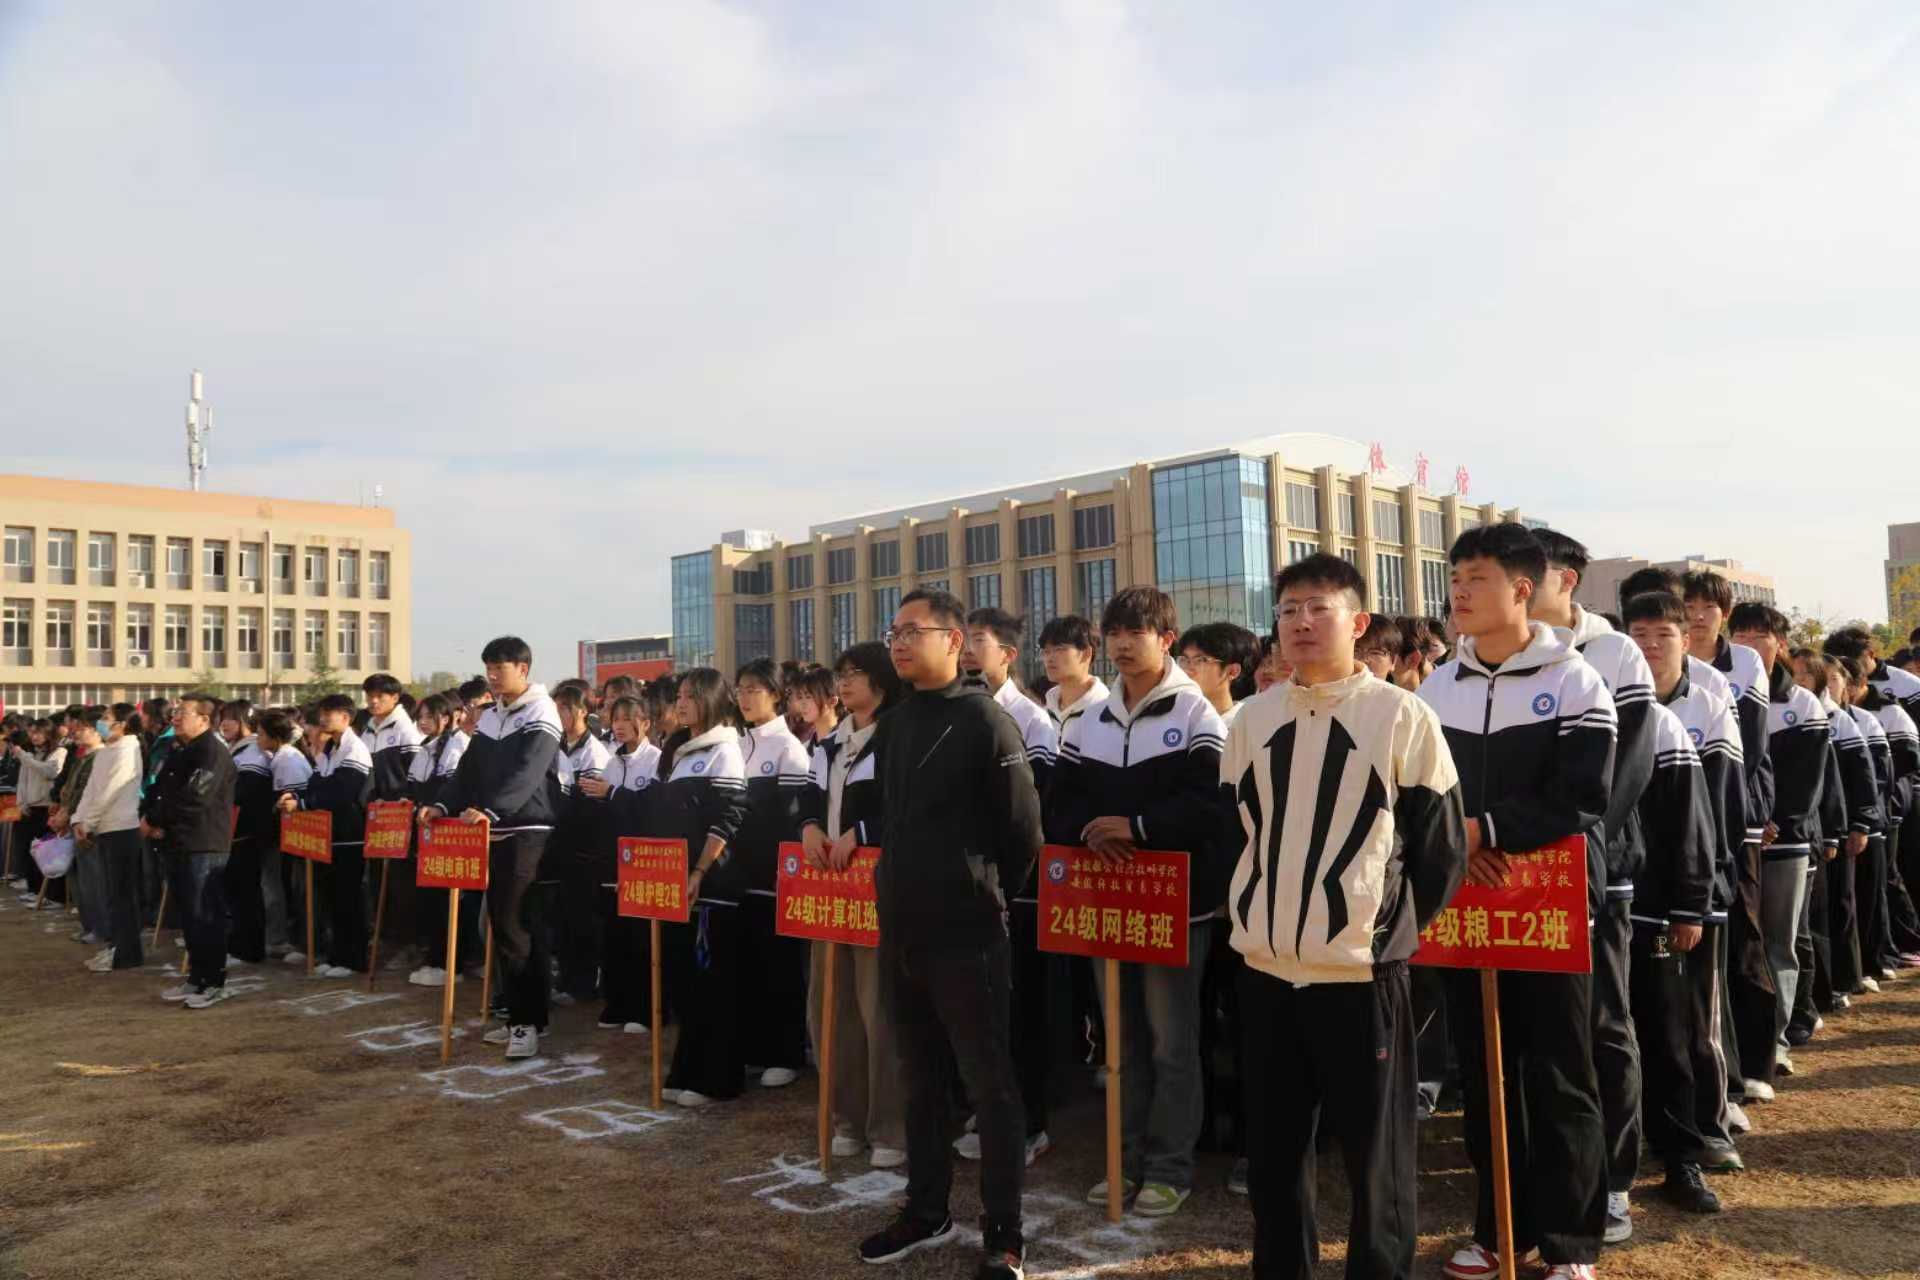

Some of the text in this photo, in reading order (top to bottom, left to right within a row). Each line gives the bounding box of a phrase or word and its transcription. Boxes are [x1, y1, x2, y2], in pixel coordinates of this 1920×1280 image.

[785, 894, 880, 931] 24级计算机班
[1050, 905, 1174, 948] 24级网络班
